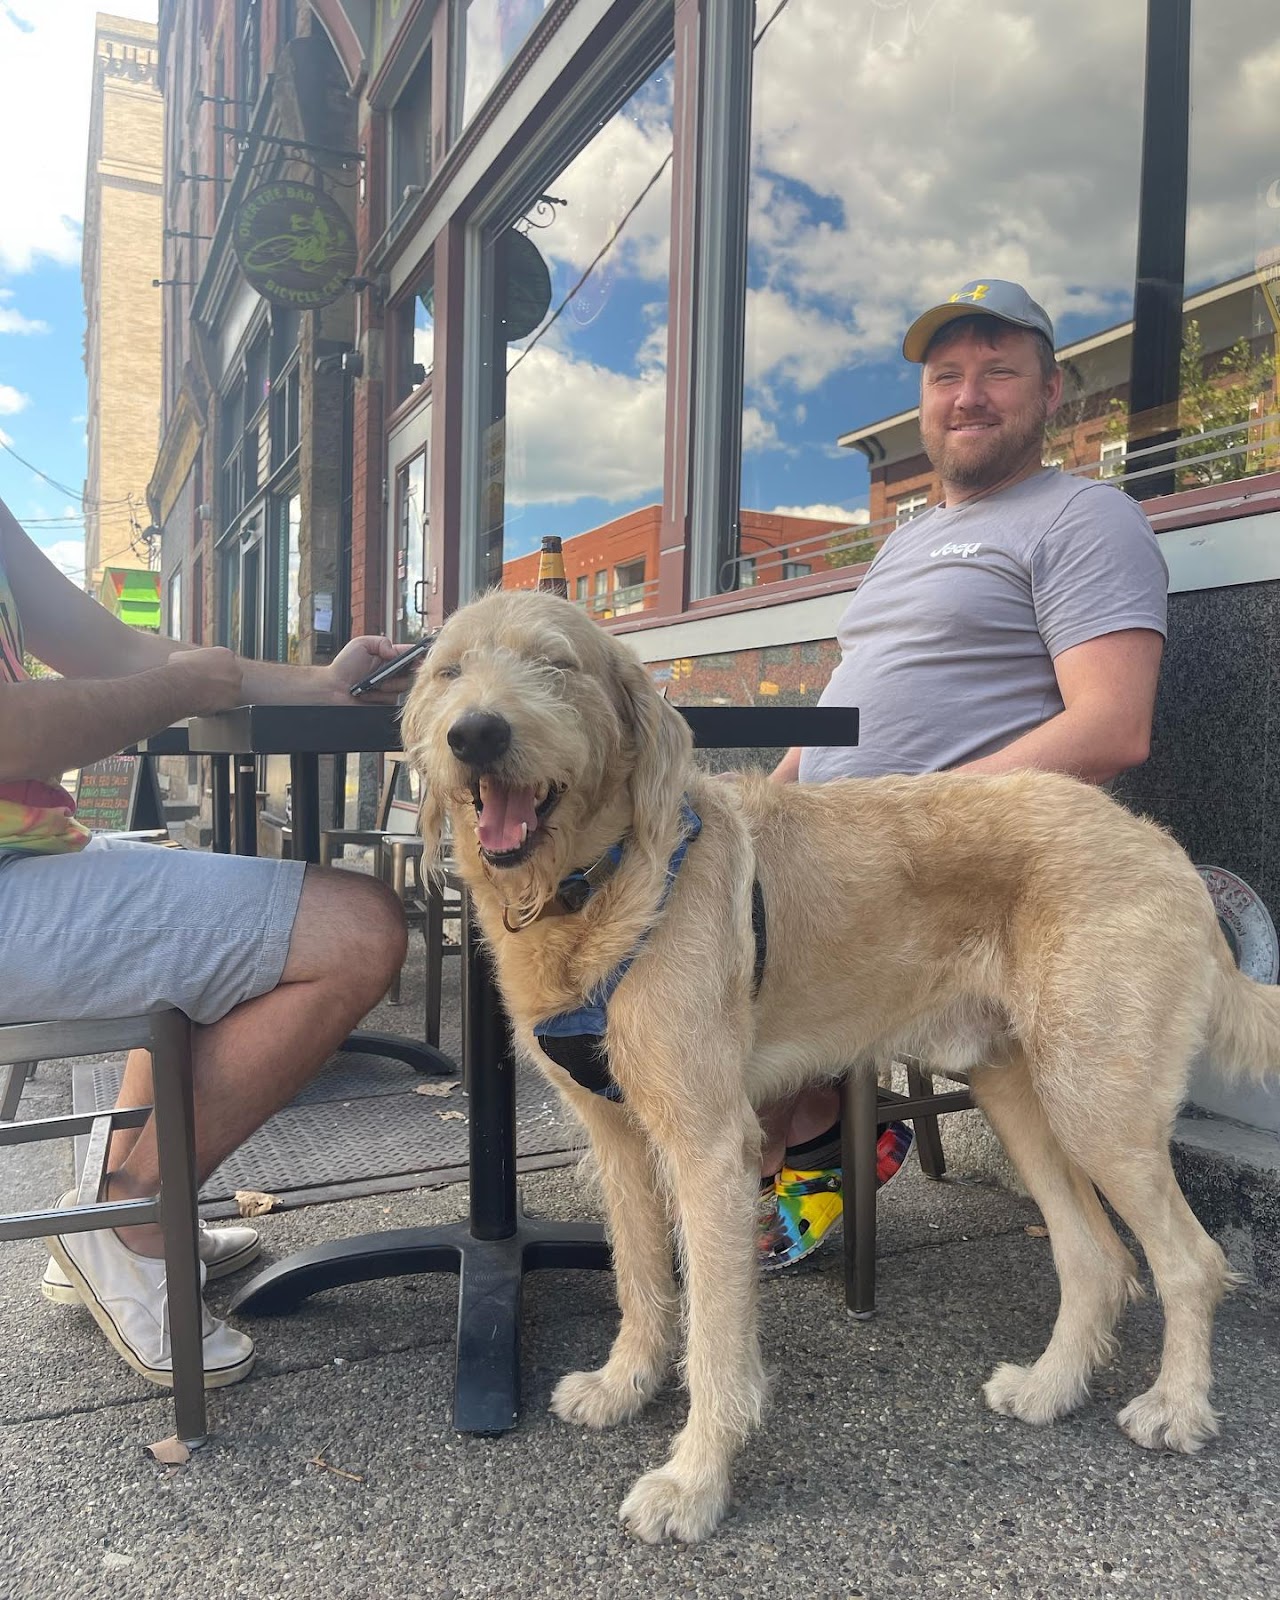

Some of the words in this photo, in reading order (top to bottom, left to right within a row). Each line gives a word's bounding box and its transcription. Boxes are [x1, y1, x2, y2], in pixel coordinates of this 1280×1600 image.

[240, 202, 257, 237] OVER
[256, 187, 281, 206] THE
[286, 187, 315, 203] BAR
[265, 279, 319, 303] BICYCLE
[930, 541, 982, 559] Jeep
